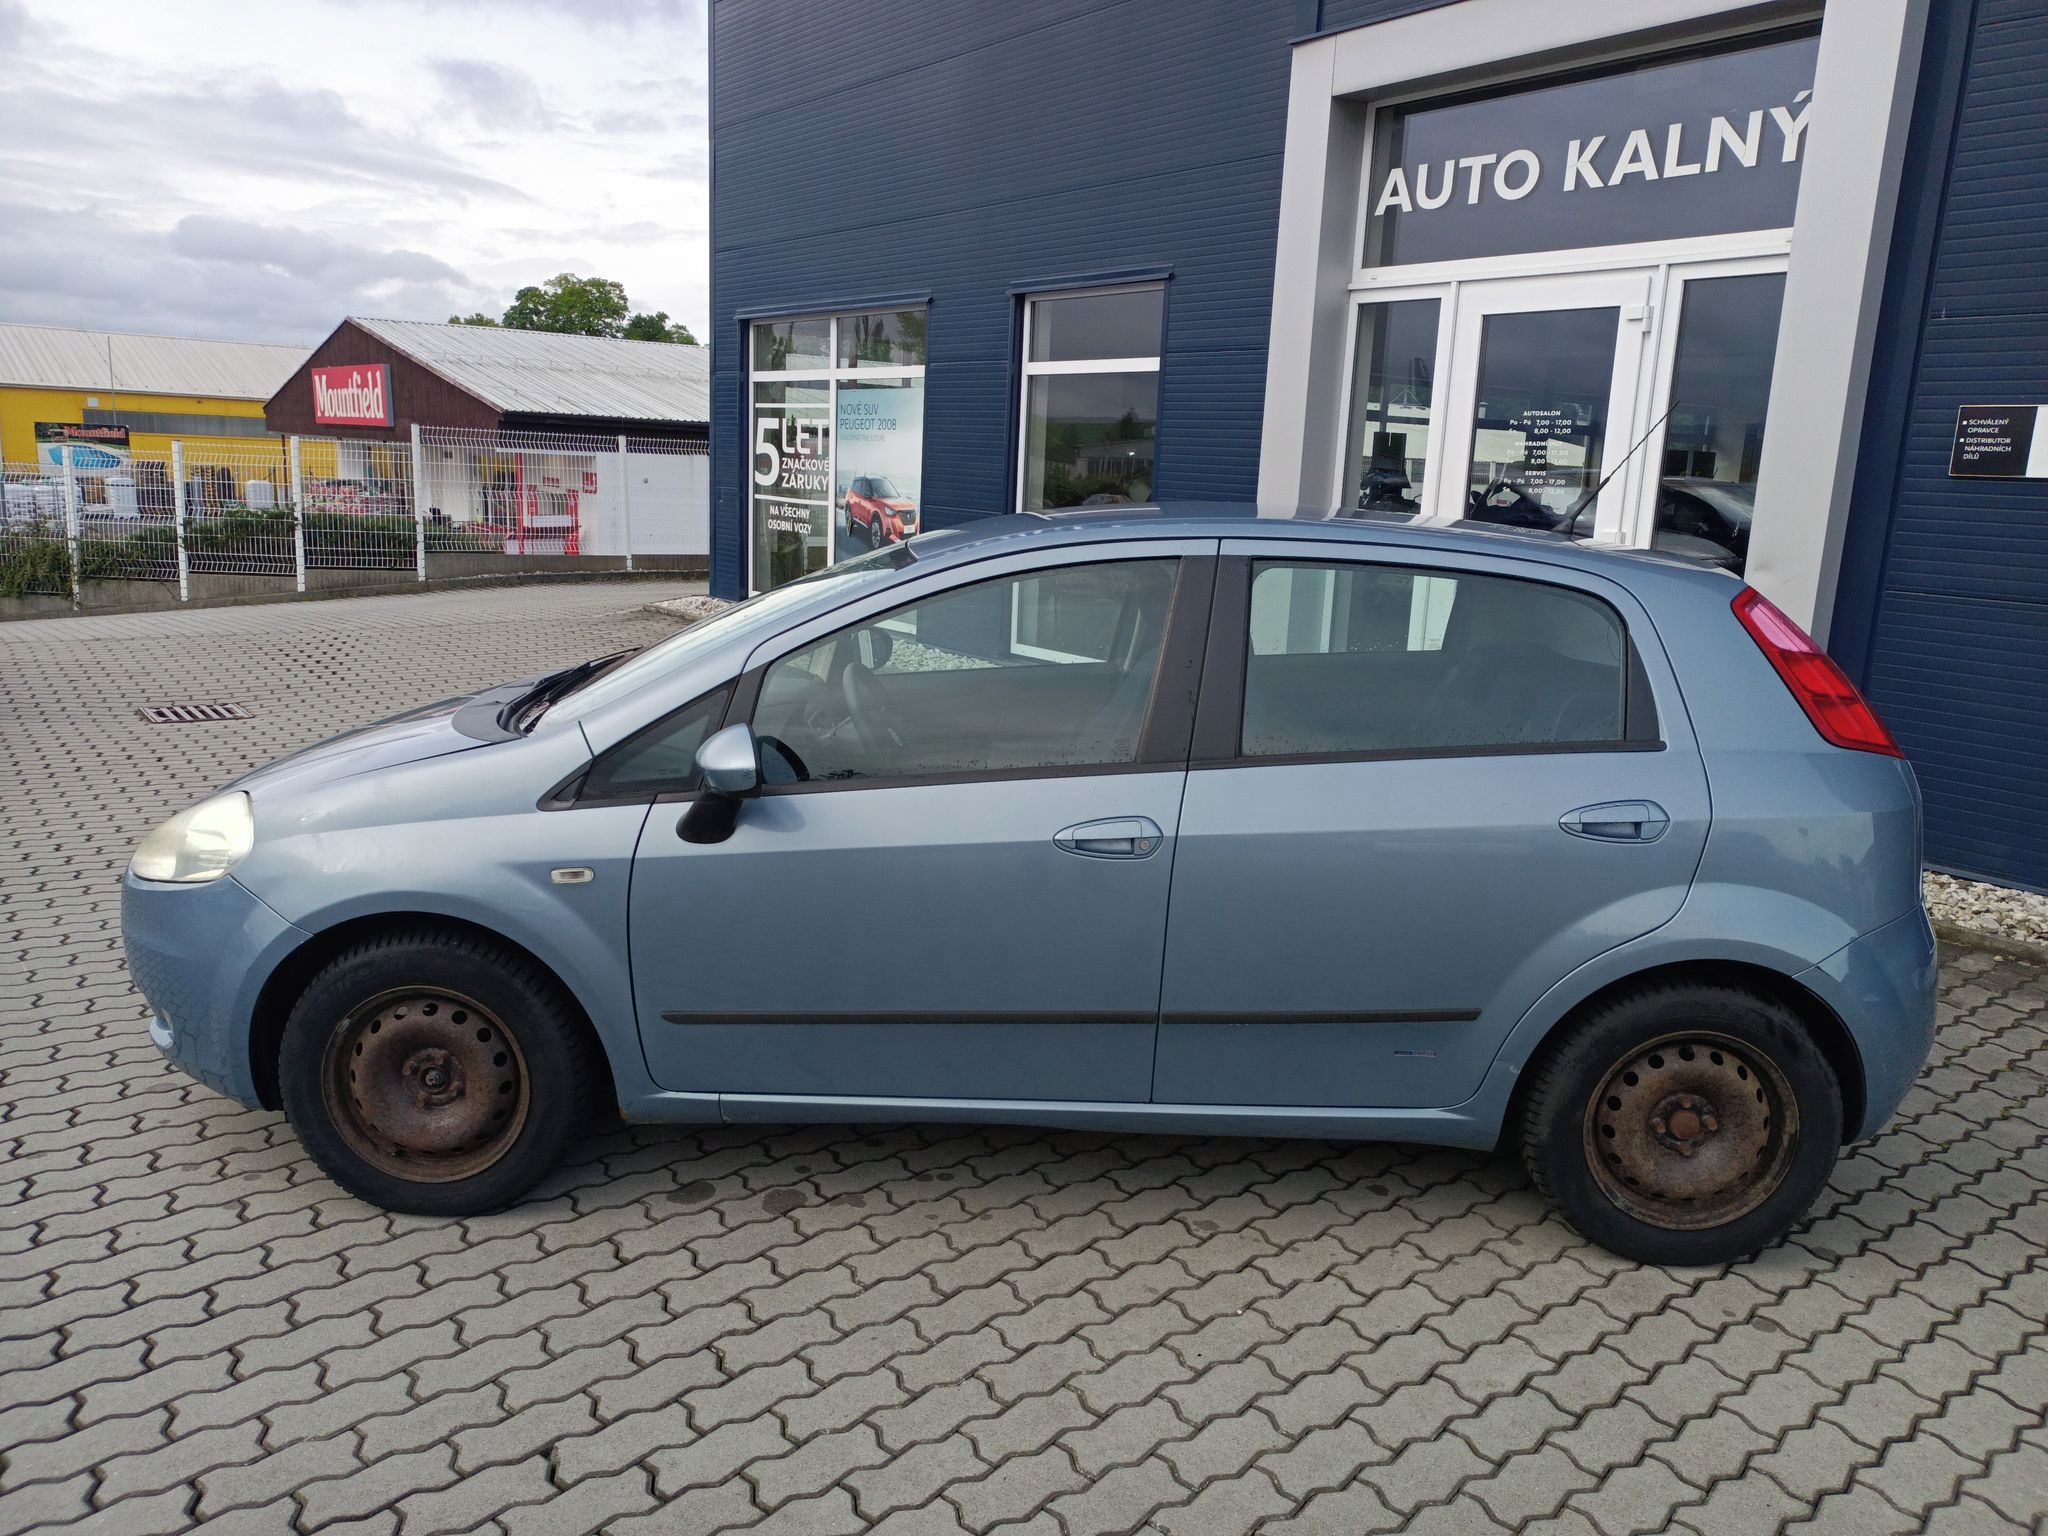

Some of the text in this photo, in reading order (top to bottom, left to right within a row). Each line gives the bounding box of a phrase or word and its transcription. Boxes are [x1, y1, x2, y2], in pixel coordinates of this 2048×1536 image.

[1374, 89, 1814, 216] AUTO KALNÝ
[314, 370, 384, 419] Mountfield
[840, 400, 879, 416] NOVÉ SUV
[840, 418, 897, 431] PEUGEOT 2008
[1536, 419, 1550, 427] 7,00
[1555, 419, 1572, 427] 17,00
[64, 425, 125, 438] Mountfield
[754, 417, 830, 487] 5 LET
[781, 455, 829, 473] ZNAČKOVÉ
[781, 471, 829, 491] ZÁRUKY
[769, 503, 811, 519] NA VŠECHNY
[768, 519, 813, 535] OSOBNÍ VOZY
